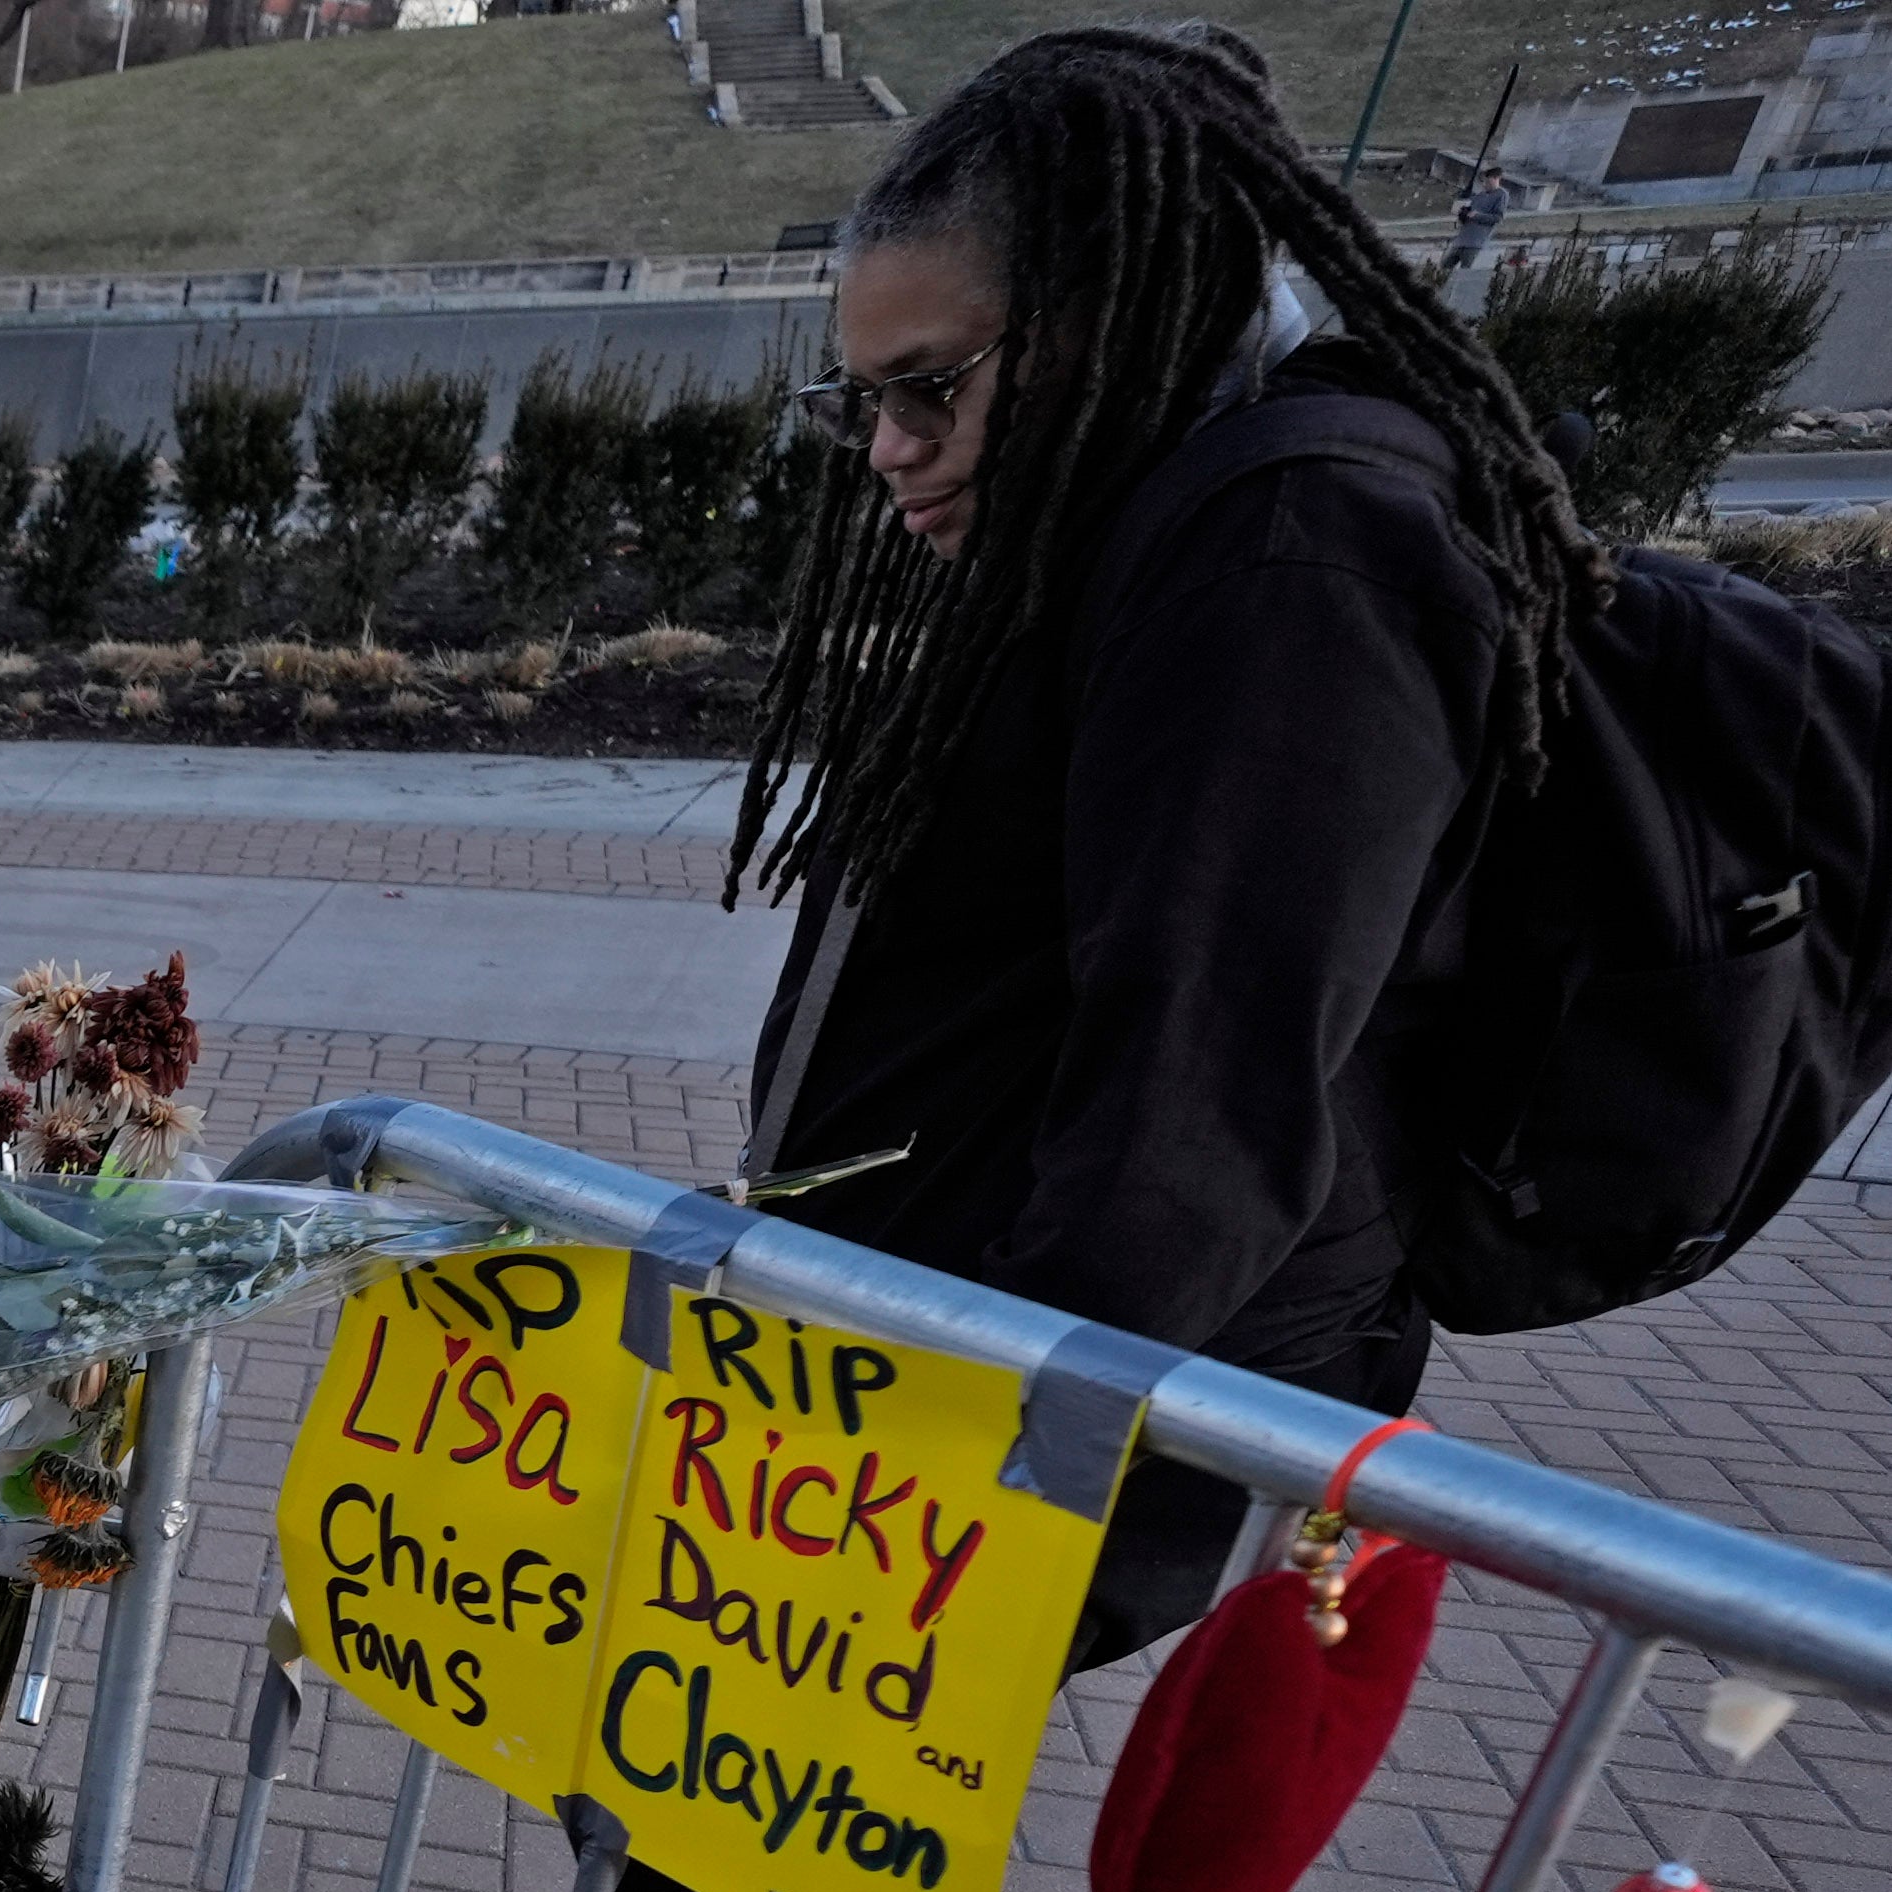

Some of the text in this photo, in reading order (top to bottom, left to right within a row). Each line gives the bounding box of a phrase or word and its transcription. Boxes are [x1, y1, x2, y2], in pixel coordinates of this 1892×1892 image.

[342, 1315, 580, 1506] Lisa
[325, 1578, 487, 1727] Fans
[645, 1513, 943, 1733] David
[602, 1650, 948, 1890] Clayton
[915, 1743, 985, 1791] and
